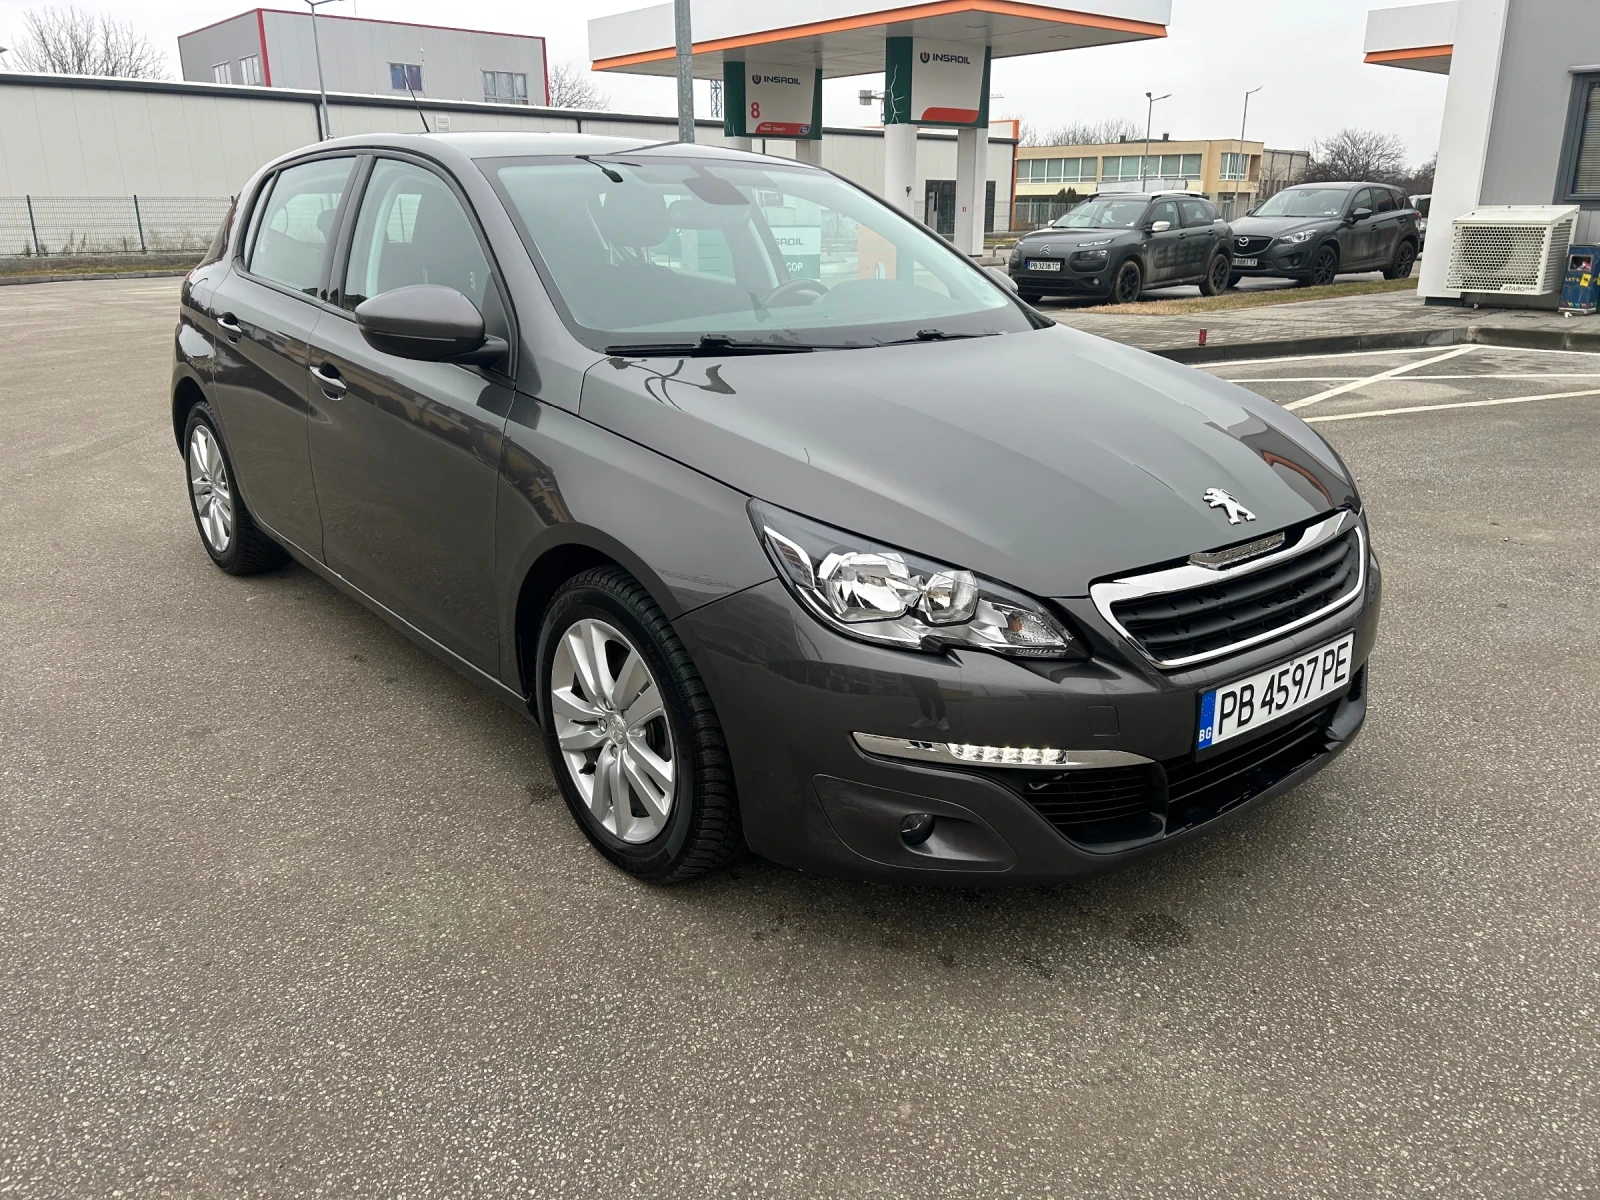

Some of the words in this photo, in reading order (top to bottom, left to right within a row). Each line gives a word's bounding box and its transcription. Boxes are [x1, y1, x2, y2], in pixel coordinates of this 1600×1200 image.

[932, 53, 971, 65] INSAOIL
[763, 75, 801, 85] INSAOIL
[751, 101, 760, 119] 8
[1218, 683, 1255, 736] PB
[1260, 655, 1320, 716] 4597
[1320, 641, 1349, 691] PE
[1198, 726, 1212, 743] BG
